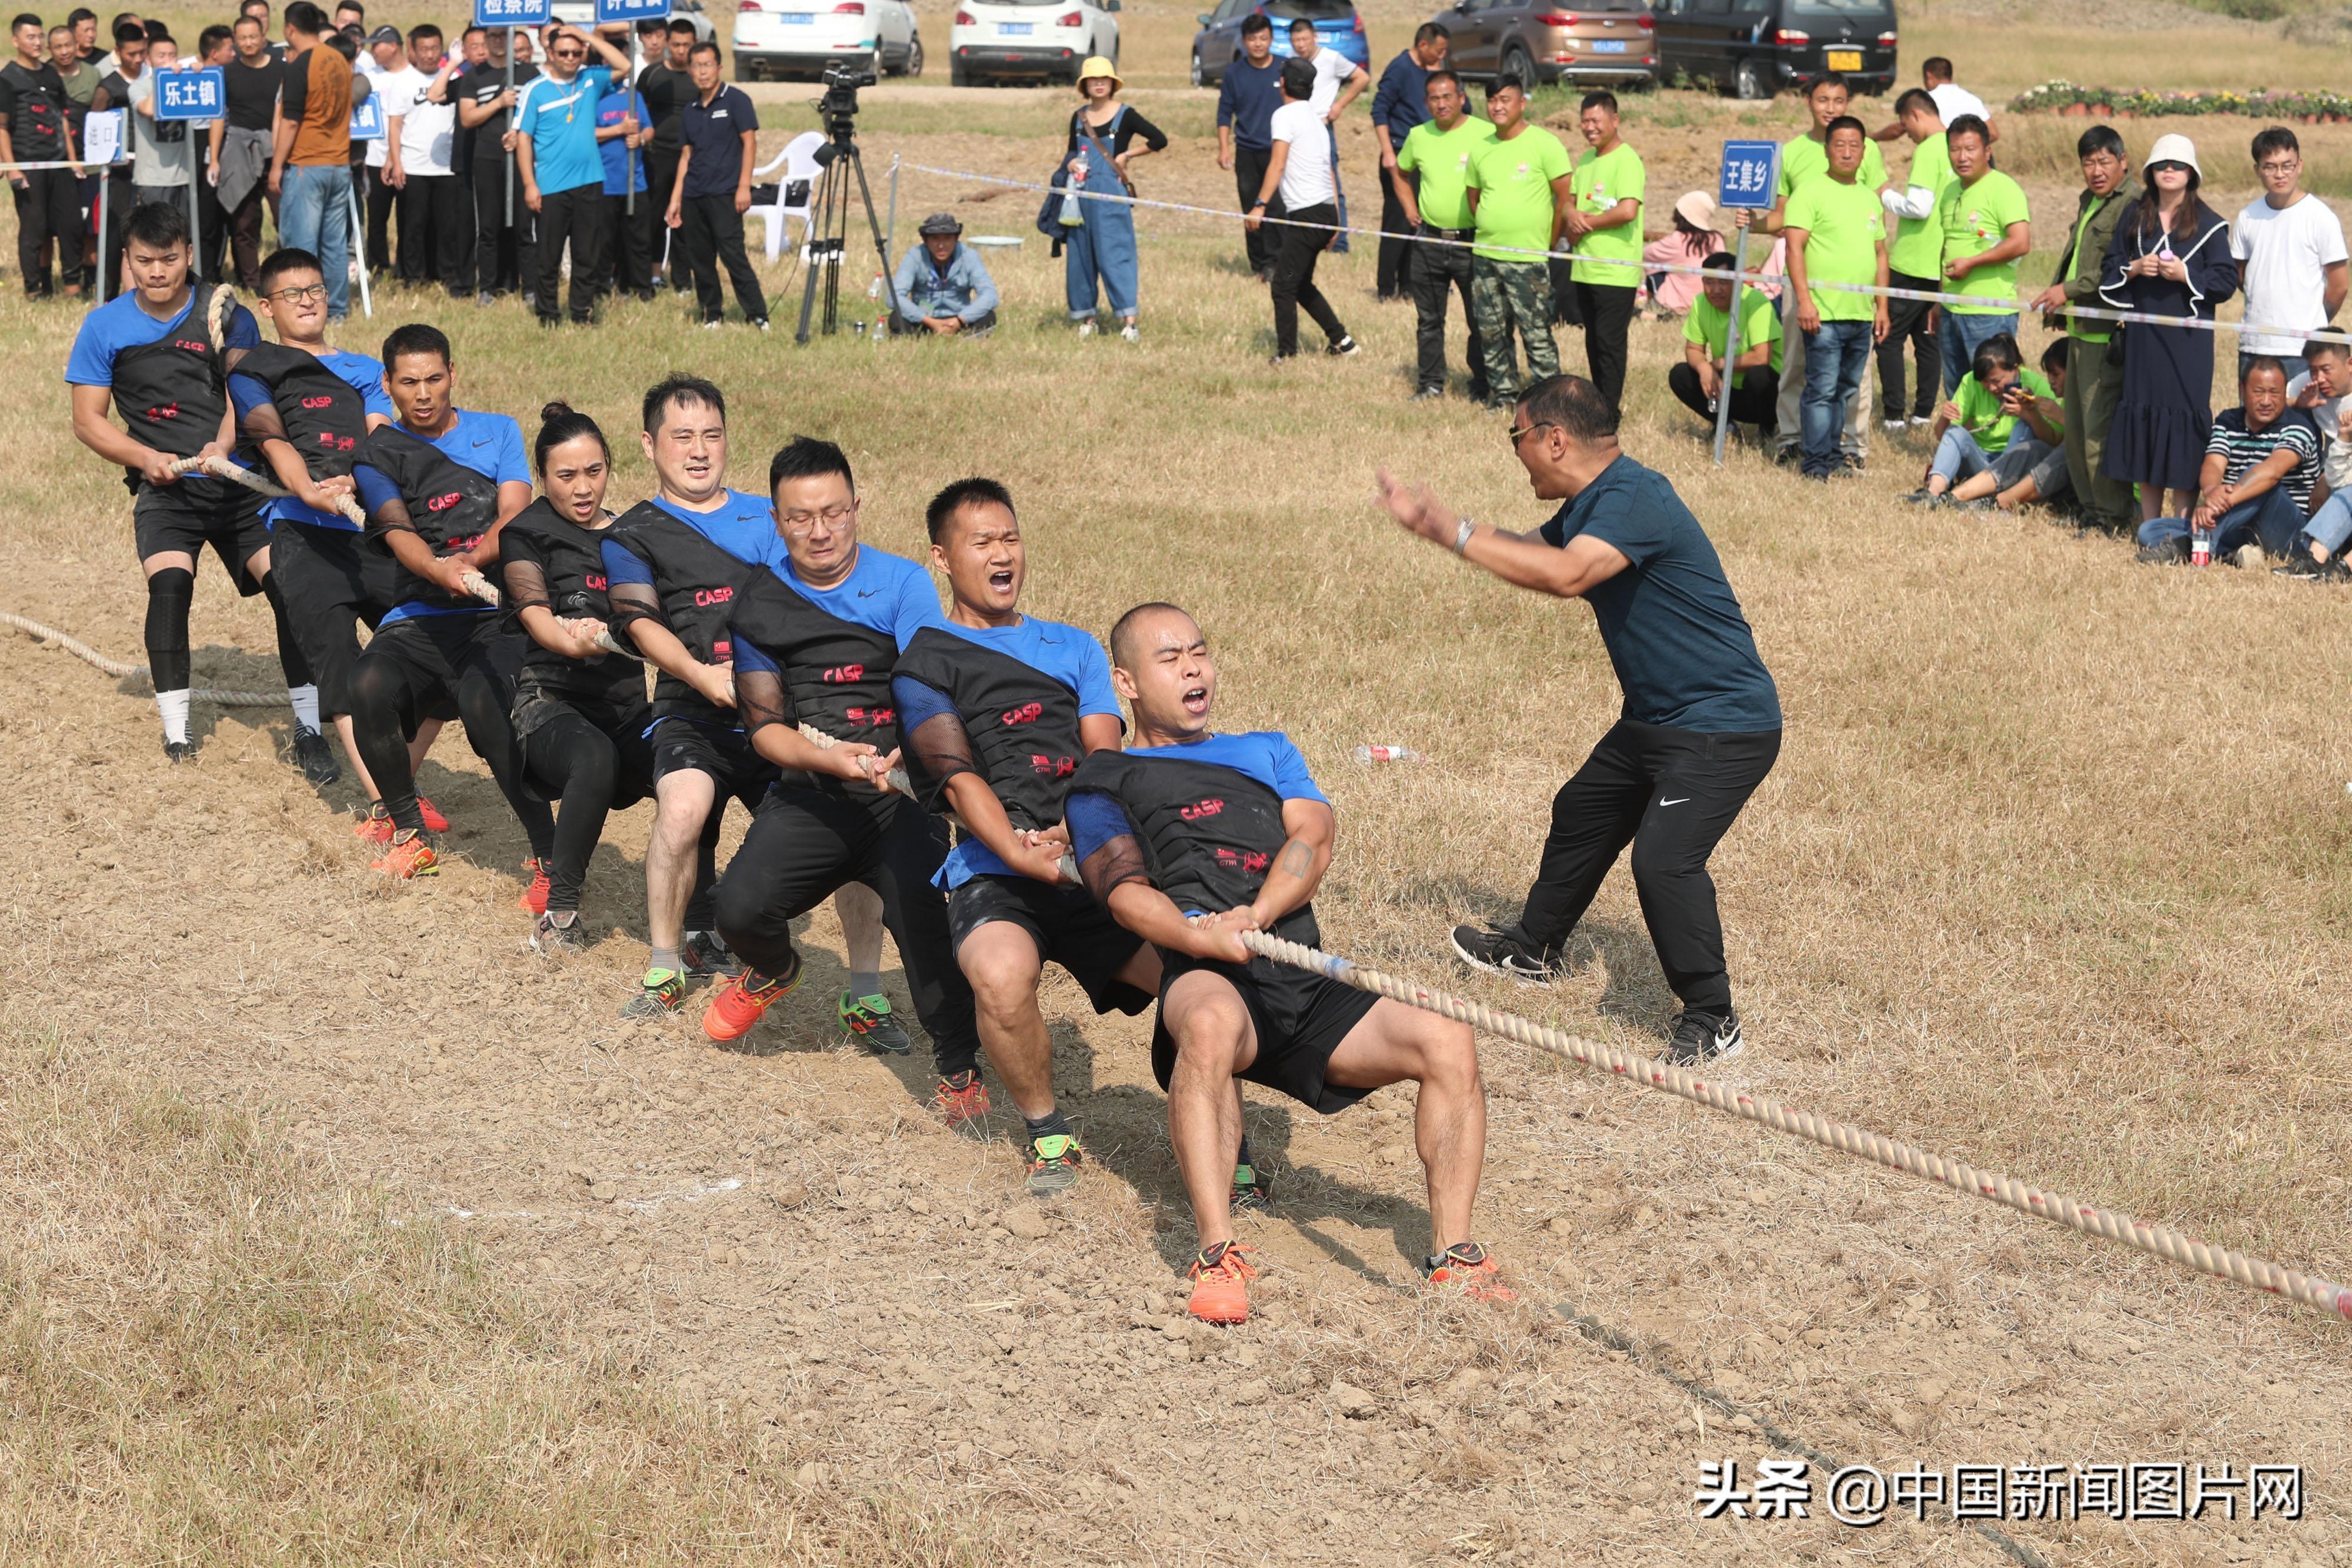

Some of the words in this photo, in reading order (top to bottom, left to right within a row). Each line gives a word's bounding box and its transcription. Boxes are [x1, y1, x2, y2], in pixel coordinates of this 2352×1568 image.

[165, 80, 216, 106] 乐土镇
[1725, 159, 1767, 192] 王集乡
[301, 395, 332, 409] CASP
[428, 492, 462, 512] CASP
[695, 586, 733, 607] CASP
[823, 663, 864, 683] CASP
[1002, 702, 1043, 726] CASP
[1180, 798, 1225, 821] CASP
